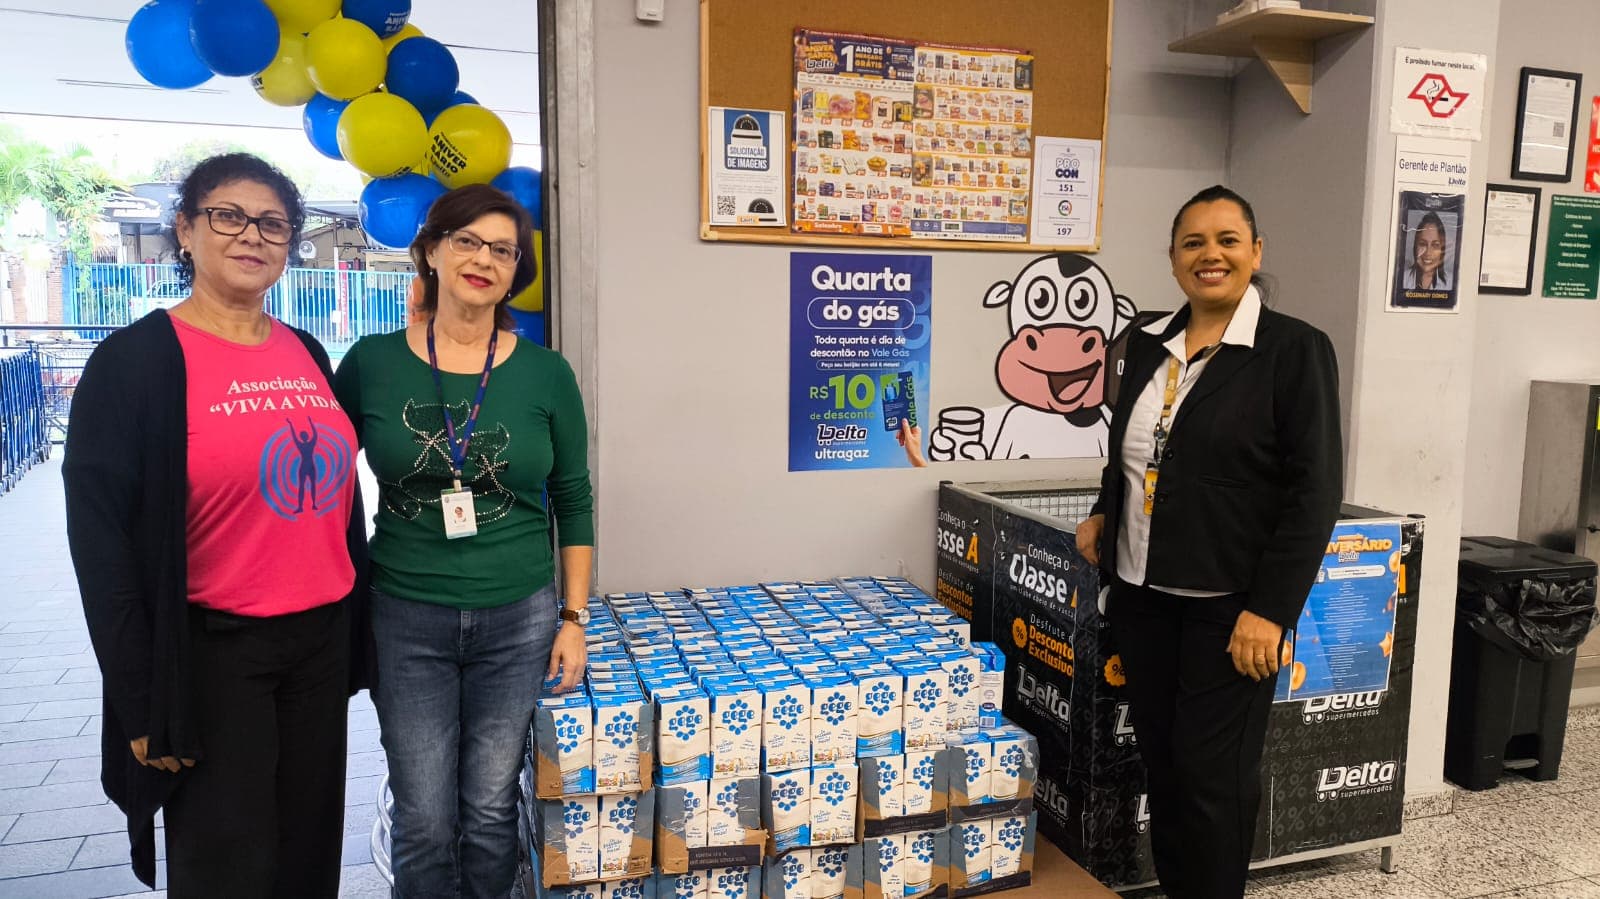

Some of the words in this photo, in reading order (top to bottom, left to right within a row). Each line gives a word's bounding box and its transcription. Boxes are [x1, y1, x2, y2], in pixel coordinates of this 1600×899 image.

[841, 44, 854, 72] 1
[856, 46, 872, 54] ANO
[874, 46, 883, 54] DE
[855, 60, 883, 68] GRÁTIS
[431, 144, 458, 173] SÁRIO
[434, 134, 466, 169] ANIVER
[729, 146, 764, 156] SOLICITAÇÃO
[727, 158, 737, 167] DE
[738, 159, 767, 169] IMAGENS
[1056, 158, 1080, 169] PRO
[1400, 159, 1428, 171] Gerente
[1429, 162, 1439, 171] de
[1440, 162, 1467, 174] Plantão
[1055, 168, 1079, 178] CON
[1059, 184, 1074, 192] 151
[811, 265, 911, 291] Quarta
[823, 300, 852, 320] do
[858, 300, 900, 327] gás
[815, 336, 836, 345] Toda
[838, 336, 869, 346] quarta
[871, 336, 876, 344] é
[879, 336, 893, 344] dia
[895, 336, 906, 344] de
[810, 348, 856, 357] descontão
[872, 348, 890, 357] Vale
[892, 348, 910, 357] Gás
[227, 376, 317, 394] Associação
[905, 376, 915, 400] Gás
[280, 396, 295, 410] A
[810, 412, 821, 420] de
[824, 410, 876, 420] desconto
[908, 402, 917, 427] Vale
[817, 424, 867, 442] Delta
[815, 448, 869, 462] ultragaz
[937, 526, 965, 558] asse
[966, 532, 979, 565] A
[1028, 544, 1062, 570] Conheça
[1064, 559, 1070, 571] o
[938, 568, 964, 588] Desfrute
[965, 582, 974, 593] de
[1009, 553, 1067, 603] Classe
[937, 578, 974, 607] Descontos
[1030, 613, 1065, 638] Desfrute
[1029, 625, 1074, 660] Desconto
[1029, 643, 1074, 677] Exclusivo
[866, 691, 896, 706] gege
[913, 688, 942, 702] gege
[1018, 664, 1070, 723] Delta
[773, 704, 804, 719] gege
[820, 702, 851, 715] gege
[1326, 709, 1379, 721] supermercados
[669, 715, 702, 731] gege
[722, 710, 755, 724] gege
[1318, 761, 1396, 795] Delta
[771, 787, 804, 801] gege
[819, 781, 851, 795] gege
[1340, 785, 1393, 798] supermercados
